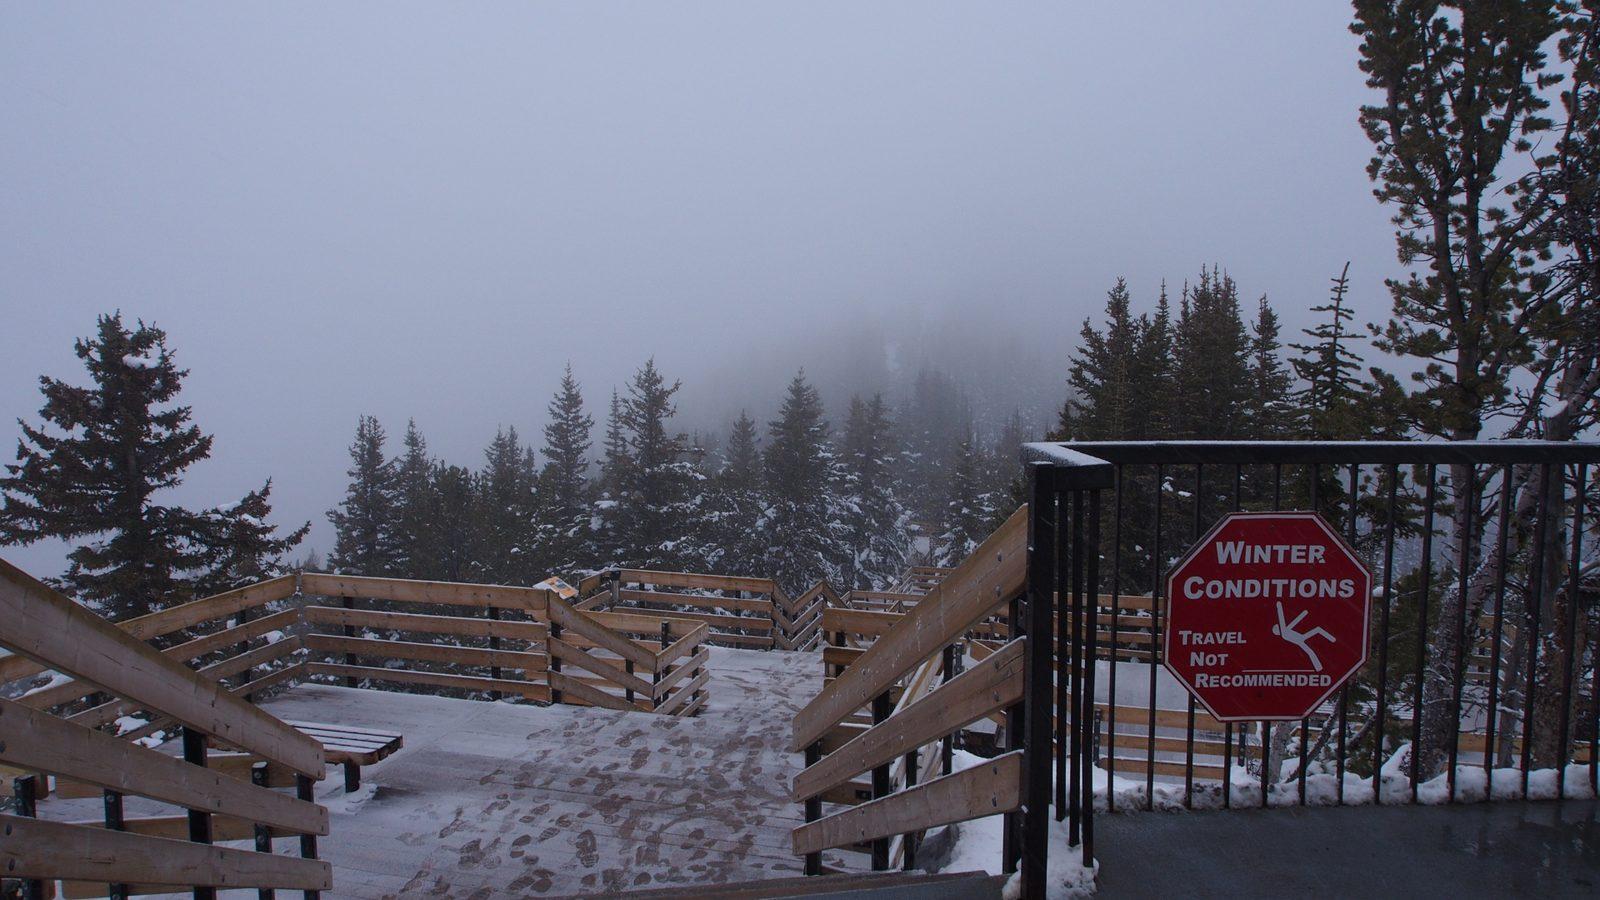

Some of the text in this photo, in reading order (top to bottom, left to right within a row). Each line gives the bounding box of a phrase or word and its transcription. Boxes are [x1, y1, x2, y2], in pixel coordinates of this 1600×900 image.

[1216, 541, 1326, 565] WINTER
[1183, 576, 1355, 600] CONDITIONS
[1179, 630, 1247, 646] TRAVEL
[1190, 651, 1229, 667] NOT
[1195, 672, 1332, 688] RECOMMENDED
